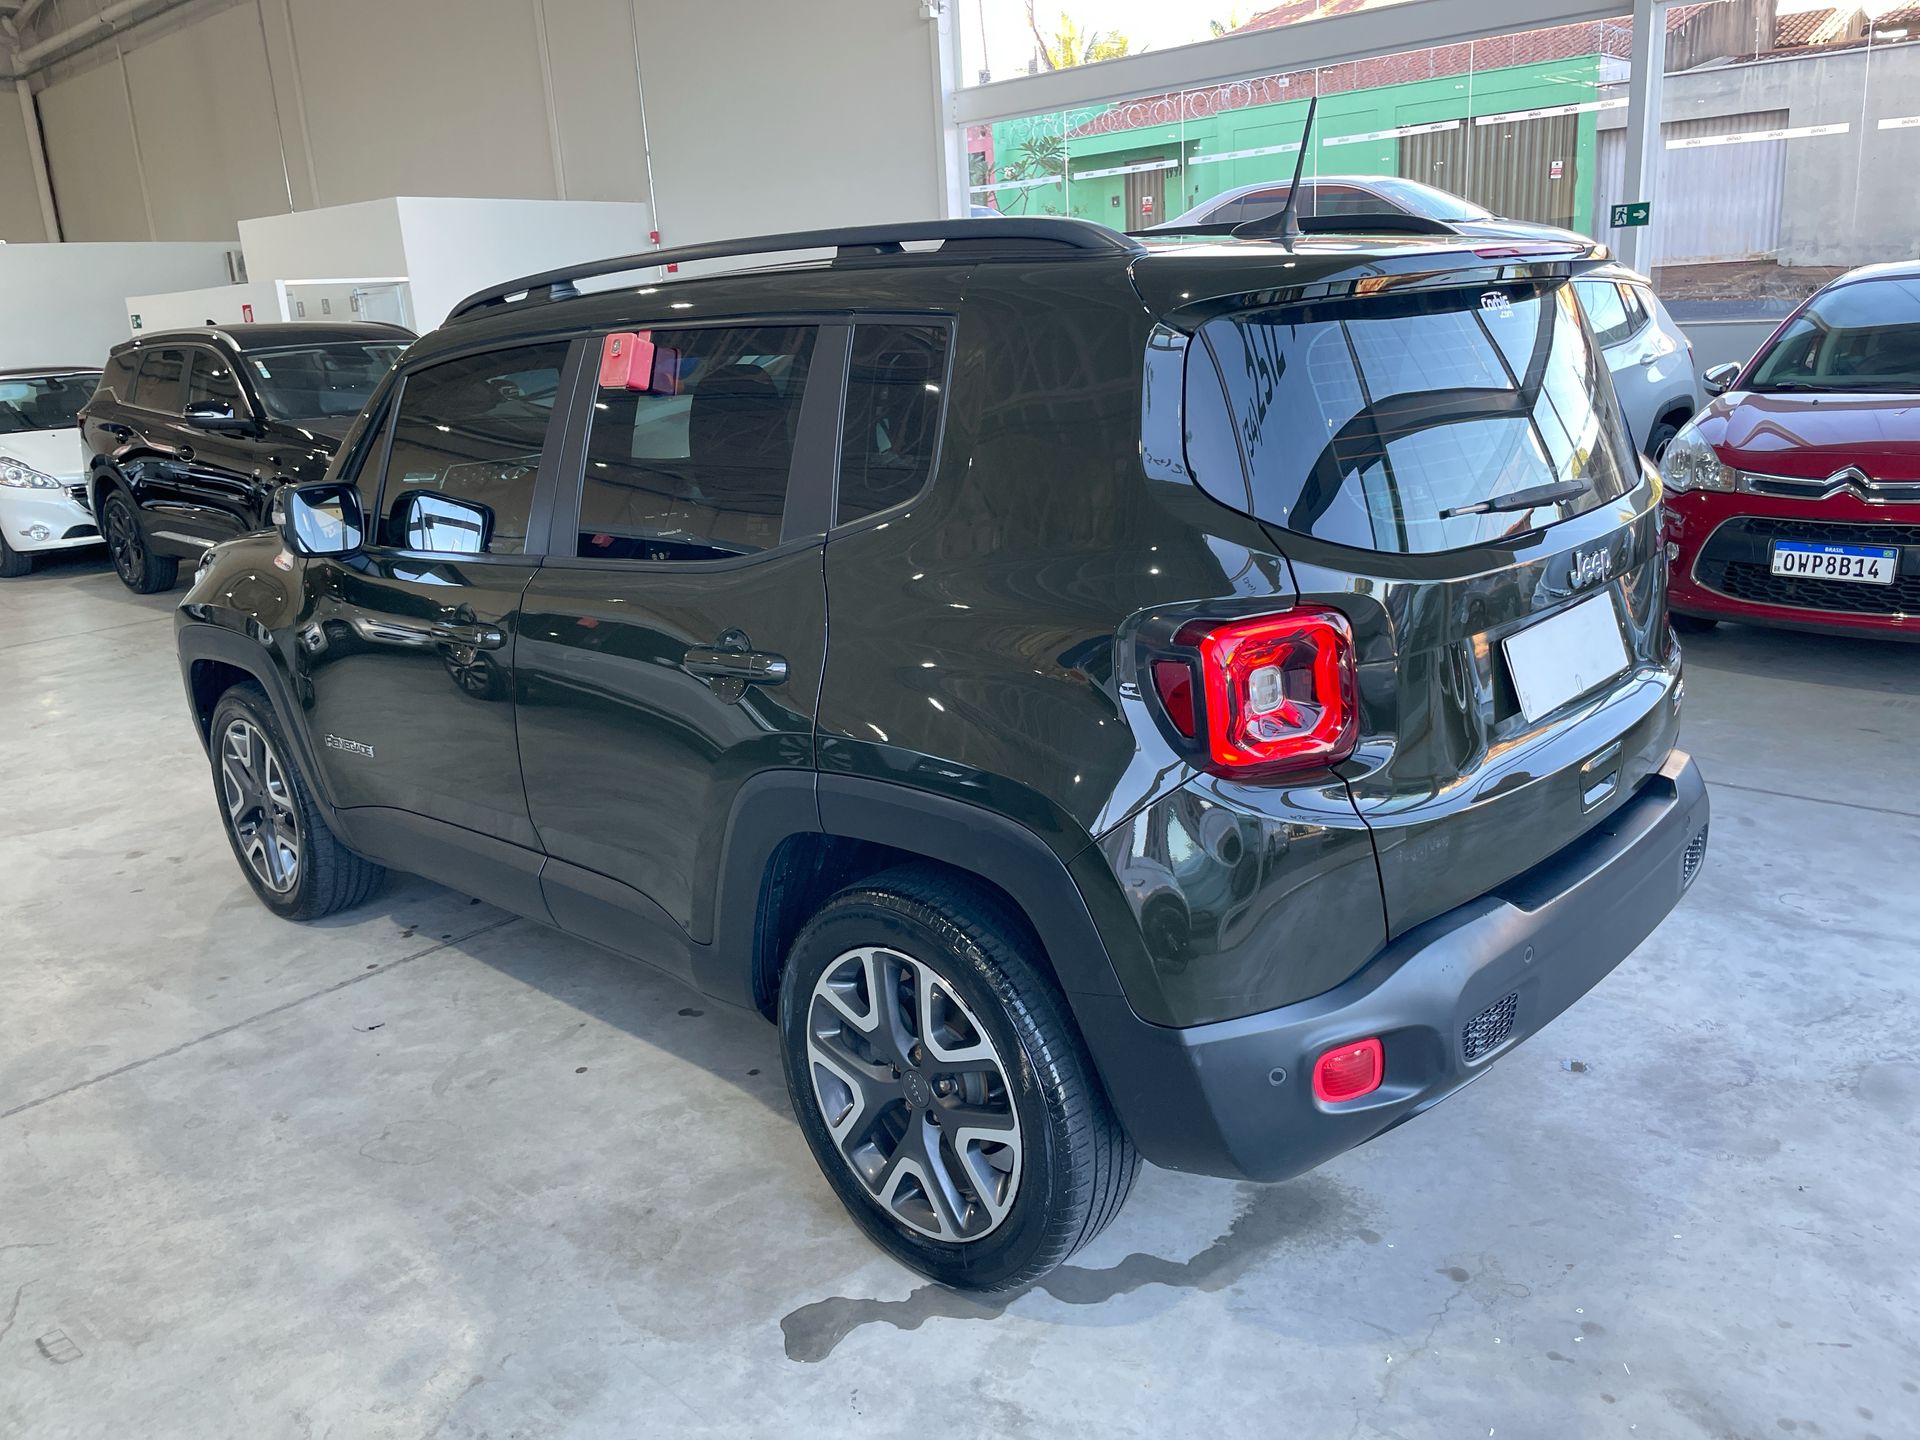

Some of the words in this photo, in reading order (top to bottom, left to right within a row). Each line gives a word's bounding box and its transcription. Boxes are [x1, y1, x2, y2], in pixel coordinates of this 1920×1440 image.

[1824, 546, 1845, 554] BRASIL
[1567, 547, 1612, 589] Jeep
[1783, 553, 1879, 579] OWP8B14
